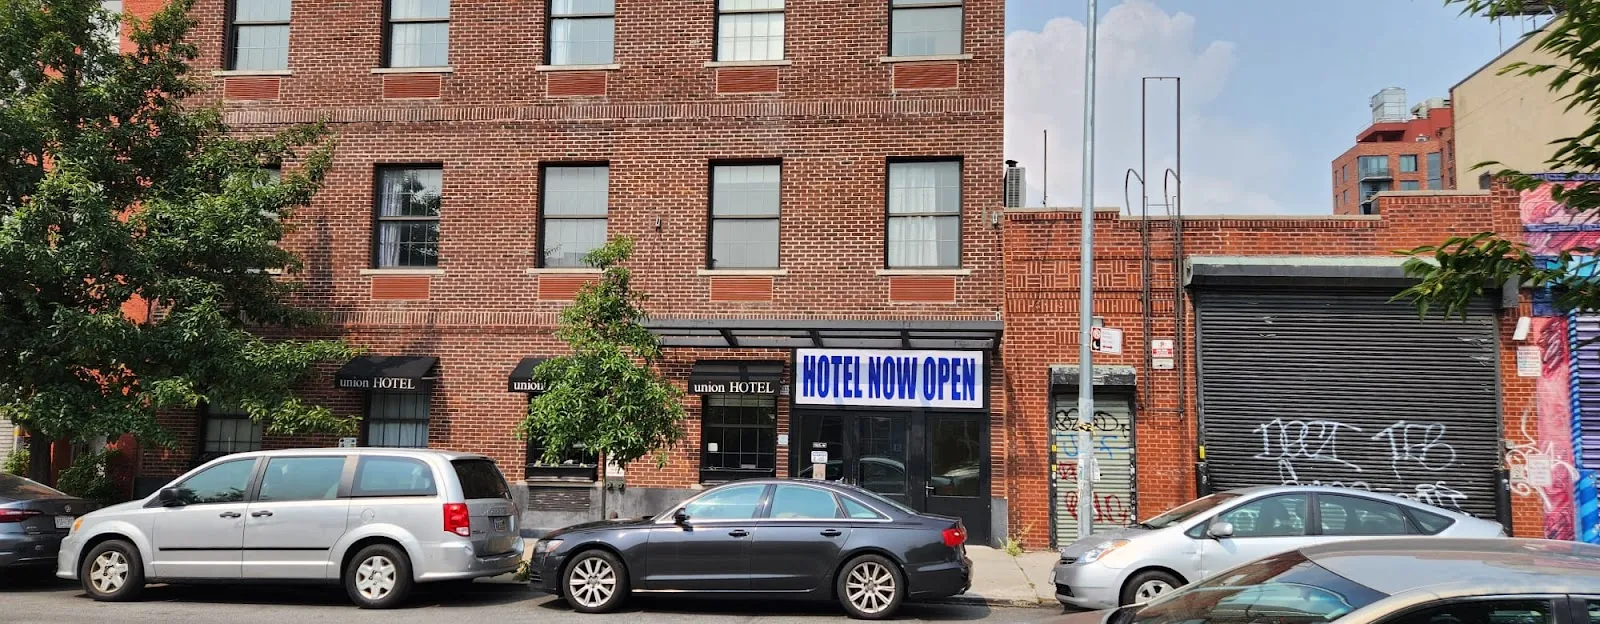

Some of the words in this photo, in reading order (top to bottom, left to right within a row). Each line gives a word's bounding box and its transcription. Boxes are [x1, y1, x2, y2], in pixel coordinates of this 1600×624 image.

[339, 376, 369, 388] union
[373, 376, 415, 390] HOTEL
[802, 354, 863, 399] HOTEL
[868, 355, 918, 400] NOW
[923, 356, 976, 401] OPEN
[693, 381, 725, 393] union
[729, 381, 774, 394] HOTEL
